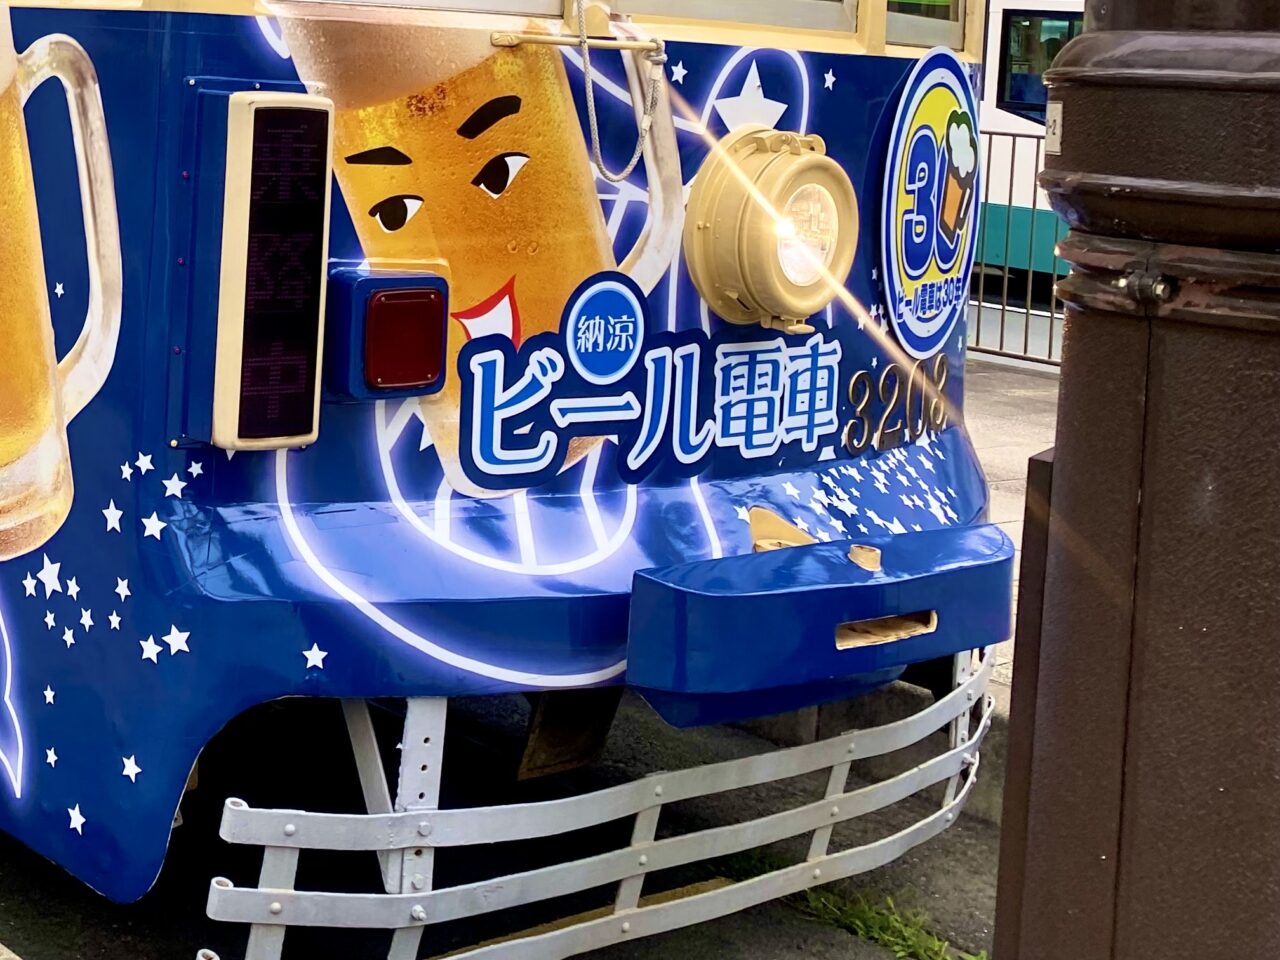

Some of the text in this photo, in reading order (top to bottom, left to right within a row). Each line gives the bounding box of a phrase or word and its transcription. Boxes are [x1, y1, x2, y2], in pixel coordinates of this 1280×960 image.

[576, 314, 635, 352] 納涼
[471, 333, 841, 476] ビール電車
